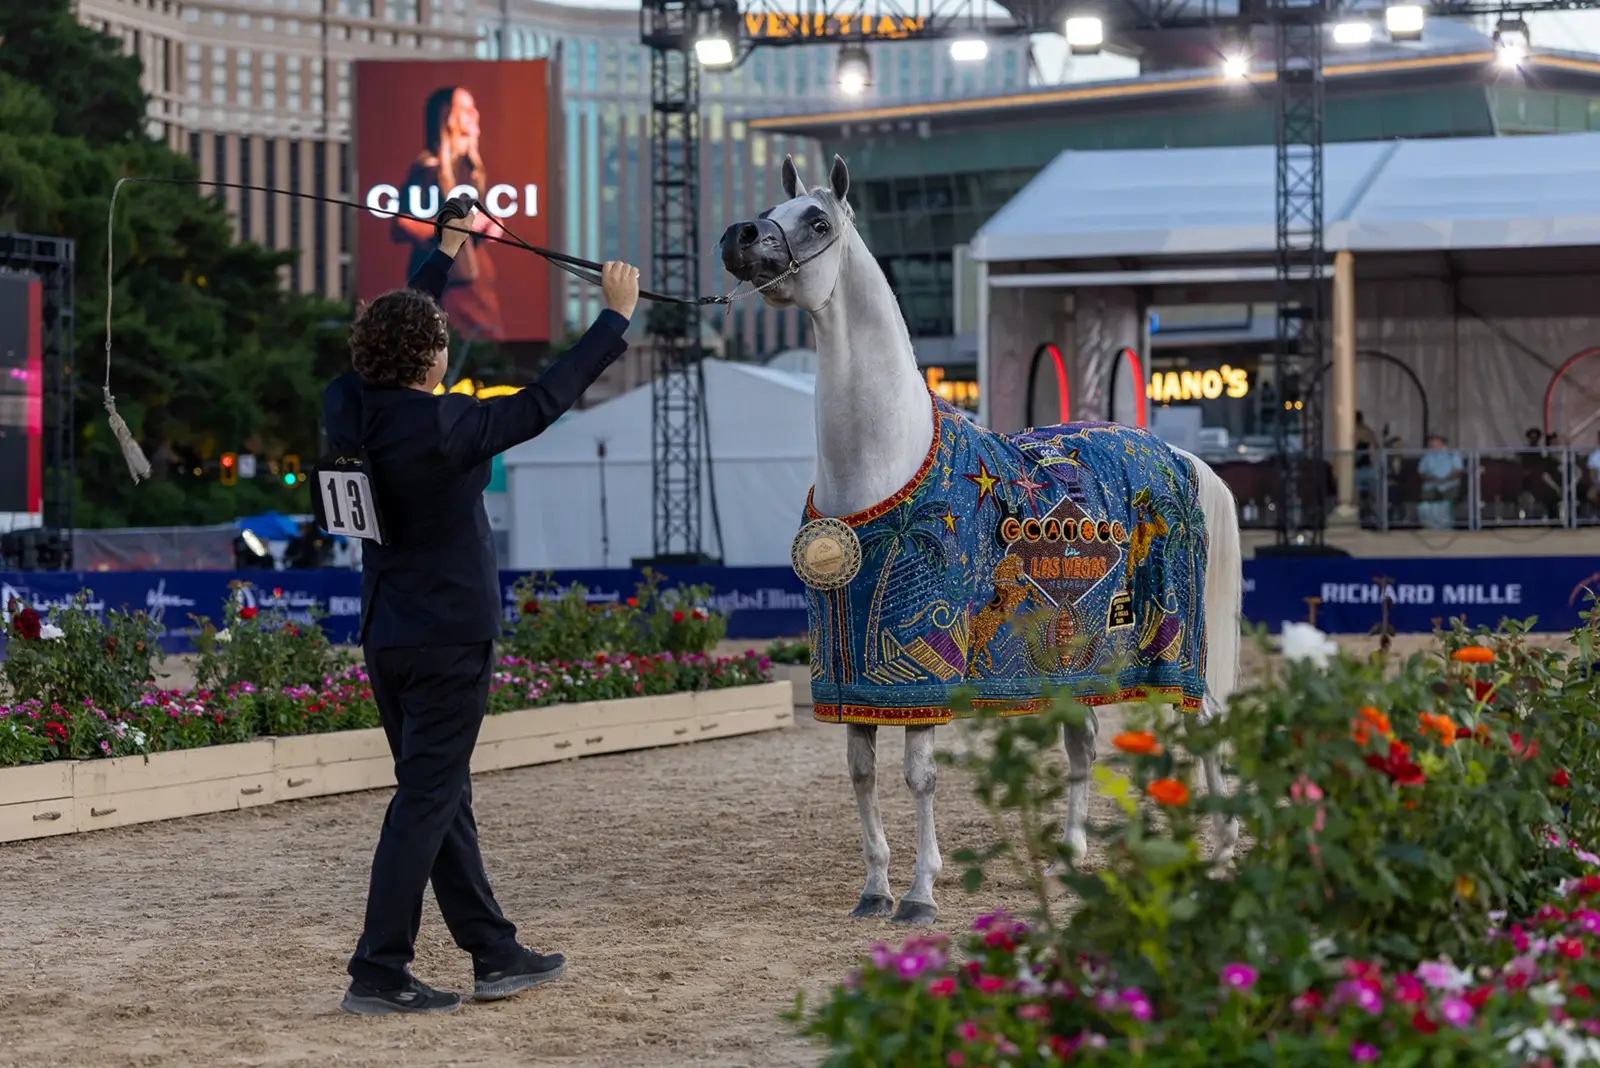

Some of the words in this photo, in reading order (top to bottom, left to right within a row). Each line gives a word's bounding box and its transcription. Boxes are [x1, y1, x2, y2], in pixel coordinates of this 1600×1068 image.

[1146, 364, 1249, 401] IANO'S
[327, 478, 366, 531] 13
[1030, 556, 1060, 578] LAS
[1062, 556, 1107, 578] VEGAS
[1321, 583, 1435, 604] RICHARD
[1443, 584, 1521, 604] MILLE
